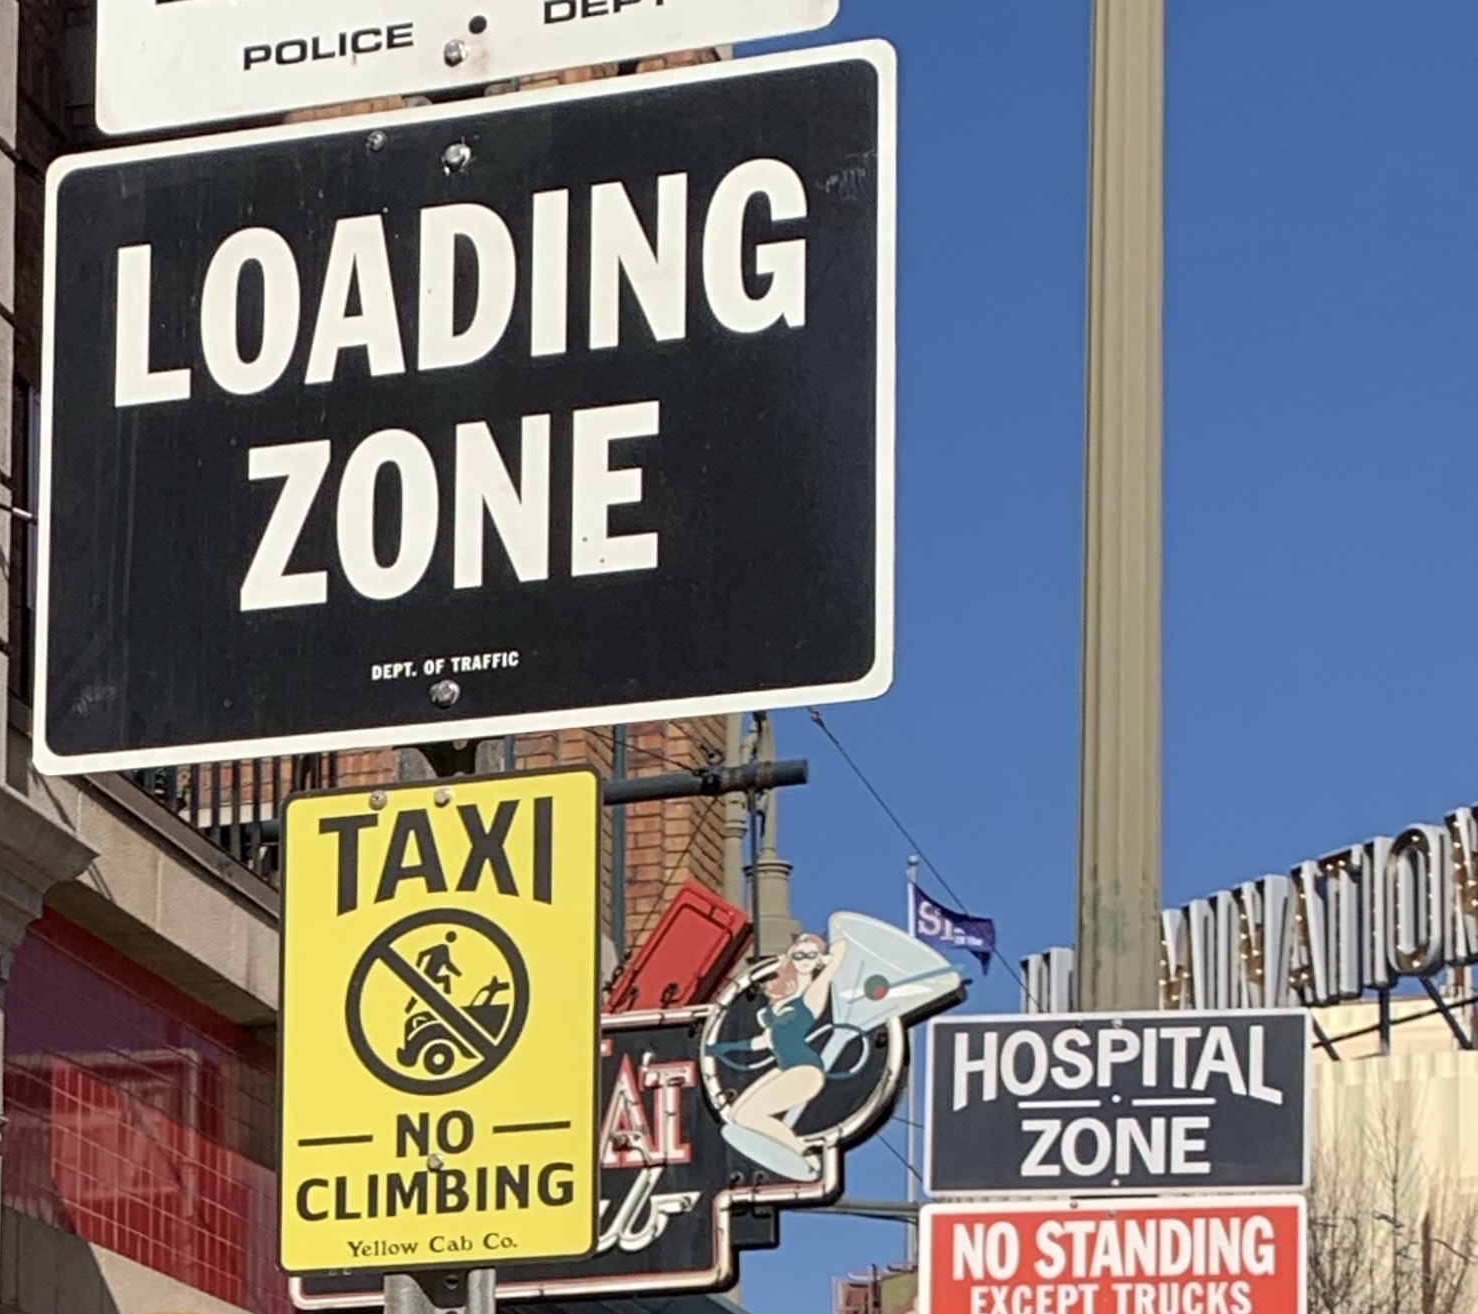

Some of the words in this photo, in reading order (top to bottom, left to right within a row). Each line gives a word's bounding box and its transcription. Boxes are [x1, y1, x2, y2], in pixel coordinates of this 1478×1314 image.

[242, 22, 414, 71] POLICE
[114, 158, 808, 408] LOADING
[239, 400, 660, 612] ZONE
[371, 661, 418, 680] DEPT.
[424, 659, 445, 675] OF
[451, 651, 520, 672] TRAFFIC
[318, 796, 554, 916] TAXI
[953, 1025, 1283, 1111] HOSPITAL
[396, 1109, 474, 1158] NO
[1021, 1116, 1211, 1177] ZONE
[296, 1162, 574, 1221] CLIMBING
[347, 1238, 419, 1259] Yellow
[429, 1235, 473, 1254] Cab
[483, 1232, 519, 1251] Co.
[952, 1222, 1019, 1281] NO
[1034, 1215, 1275, 1280] STANDING
